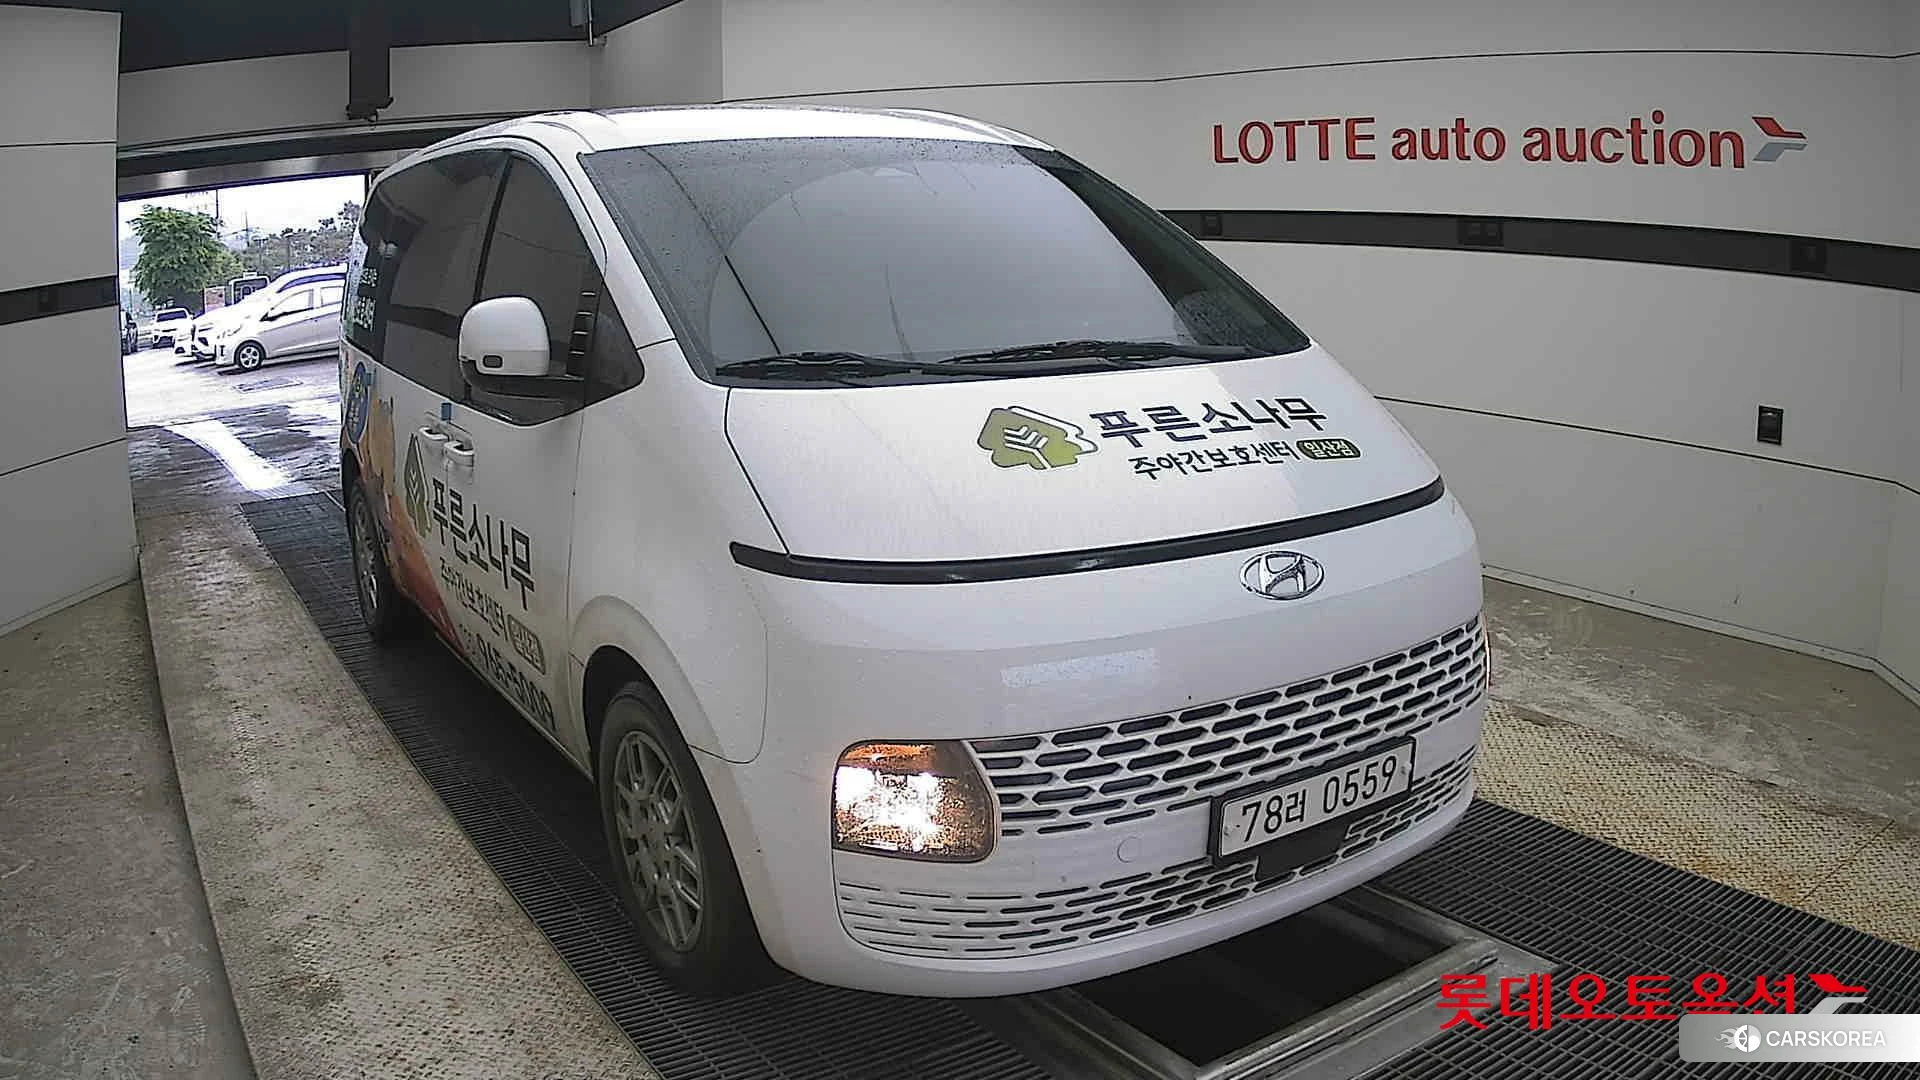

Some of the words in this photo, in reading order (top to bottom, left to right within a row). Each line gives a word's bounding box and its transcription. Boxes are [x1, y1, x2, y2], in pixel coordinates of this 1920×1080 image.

[1212, 117, 1376, 163] LOTTE
[1391, 117, 1506, 162] auto
[1522, 110, 1746, 168] auction
[1089, 398, 1328, 448] 푸른소나무
[1127, 440, 1300, 481] 주야간보호센터
[1302, 439, 1357, 458] 일산점
[432, 477, 535, 611] 푸른소나무
[1241, 788, 1307, 842] 78러
[1322, 755, 1397, 814] 0559
